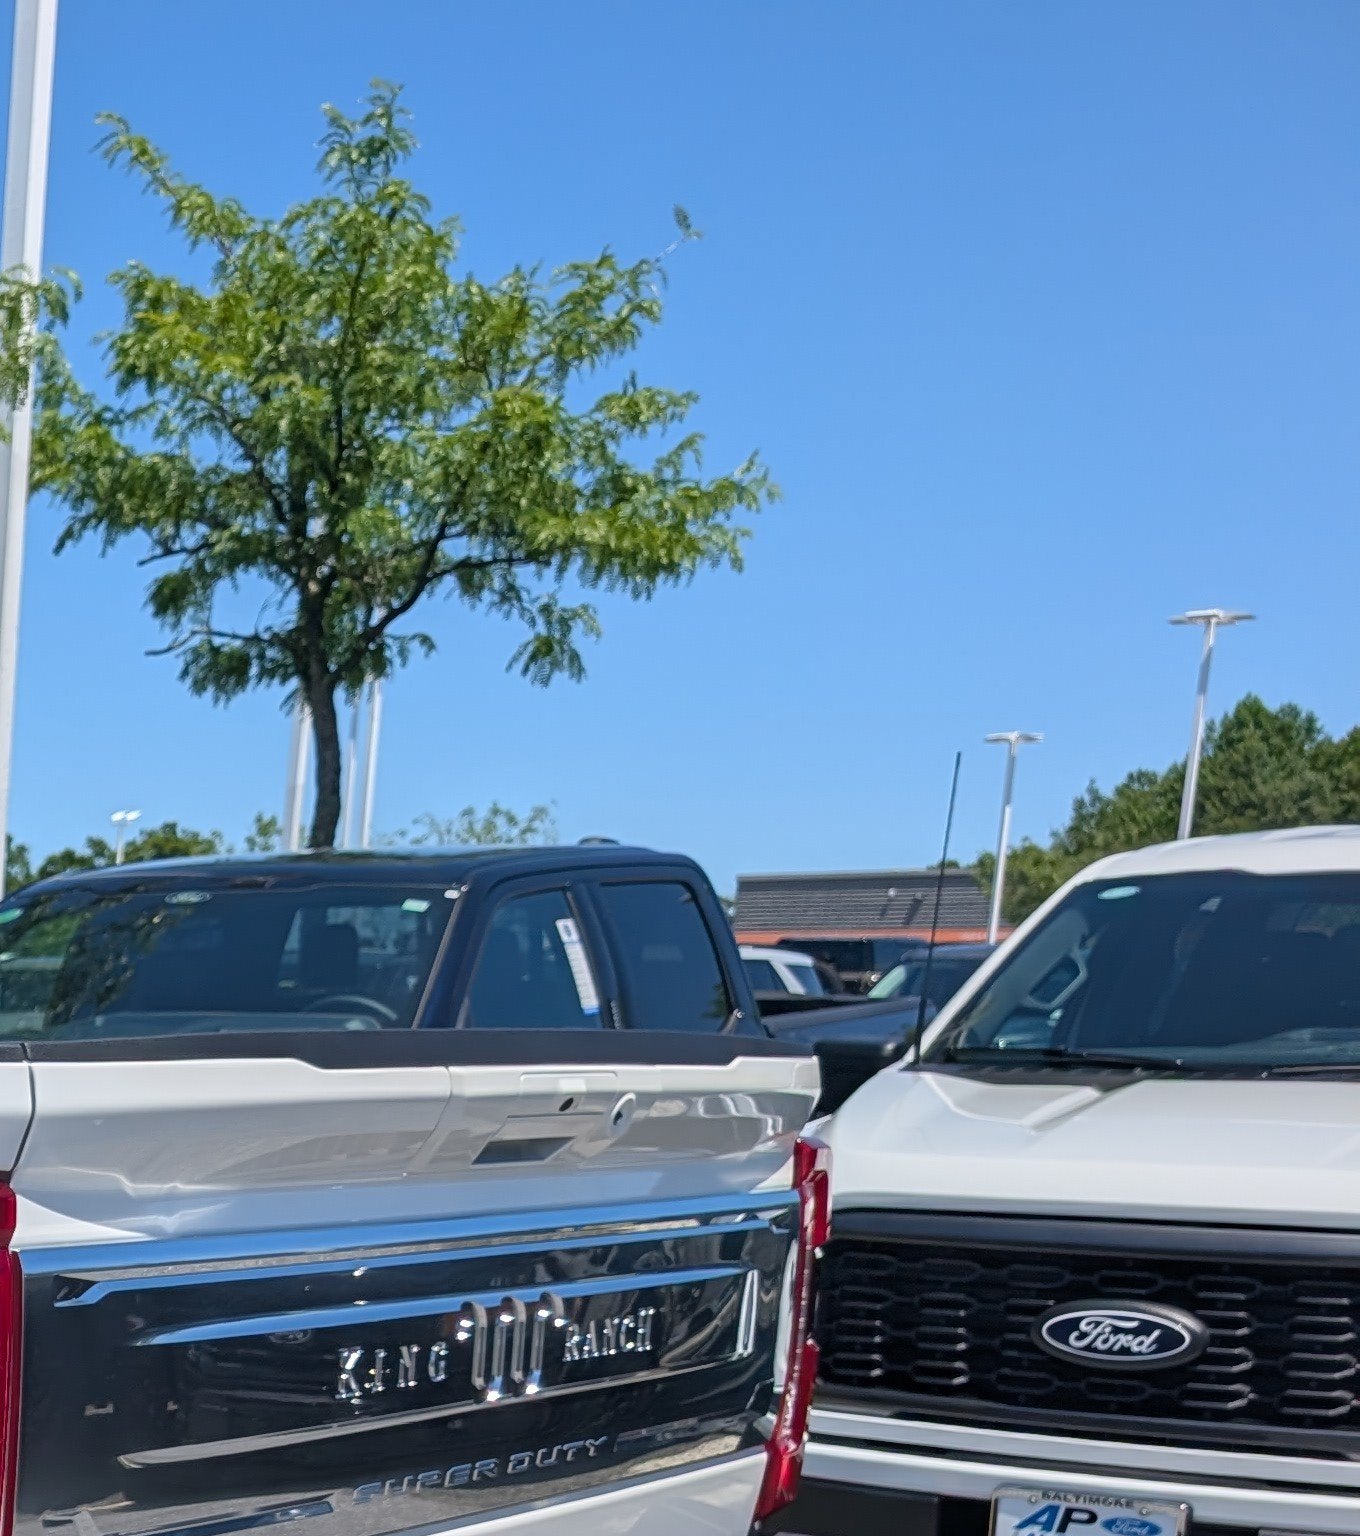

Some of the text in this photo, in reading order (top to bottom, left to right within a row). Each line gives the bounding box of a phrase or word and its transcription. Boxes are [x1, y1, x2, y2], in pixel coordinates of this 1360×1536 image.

[336, 1307, 656, 1399] KING RANCH
[1068, 1316, 1162, 1353] Ford
[353, 1436, 608, 1505] SUPER DUTY
[1013, 1504, 1098, 1534] AP
